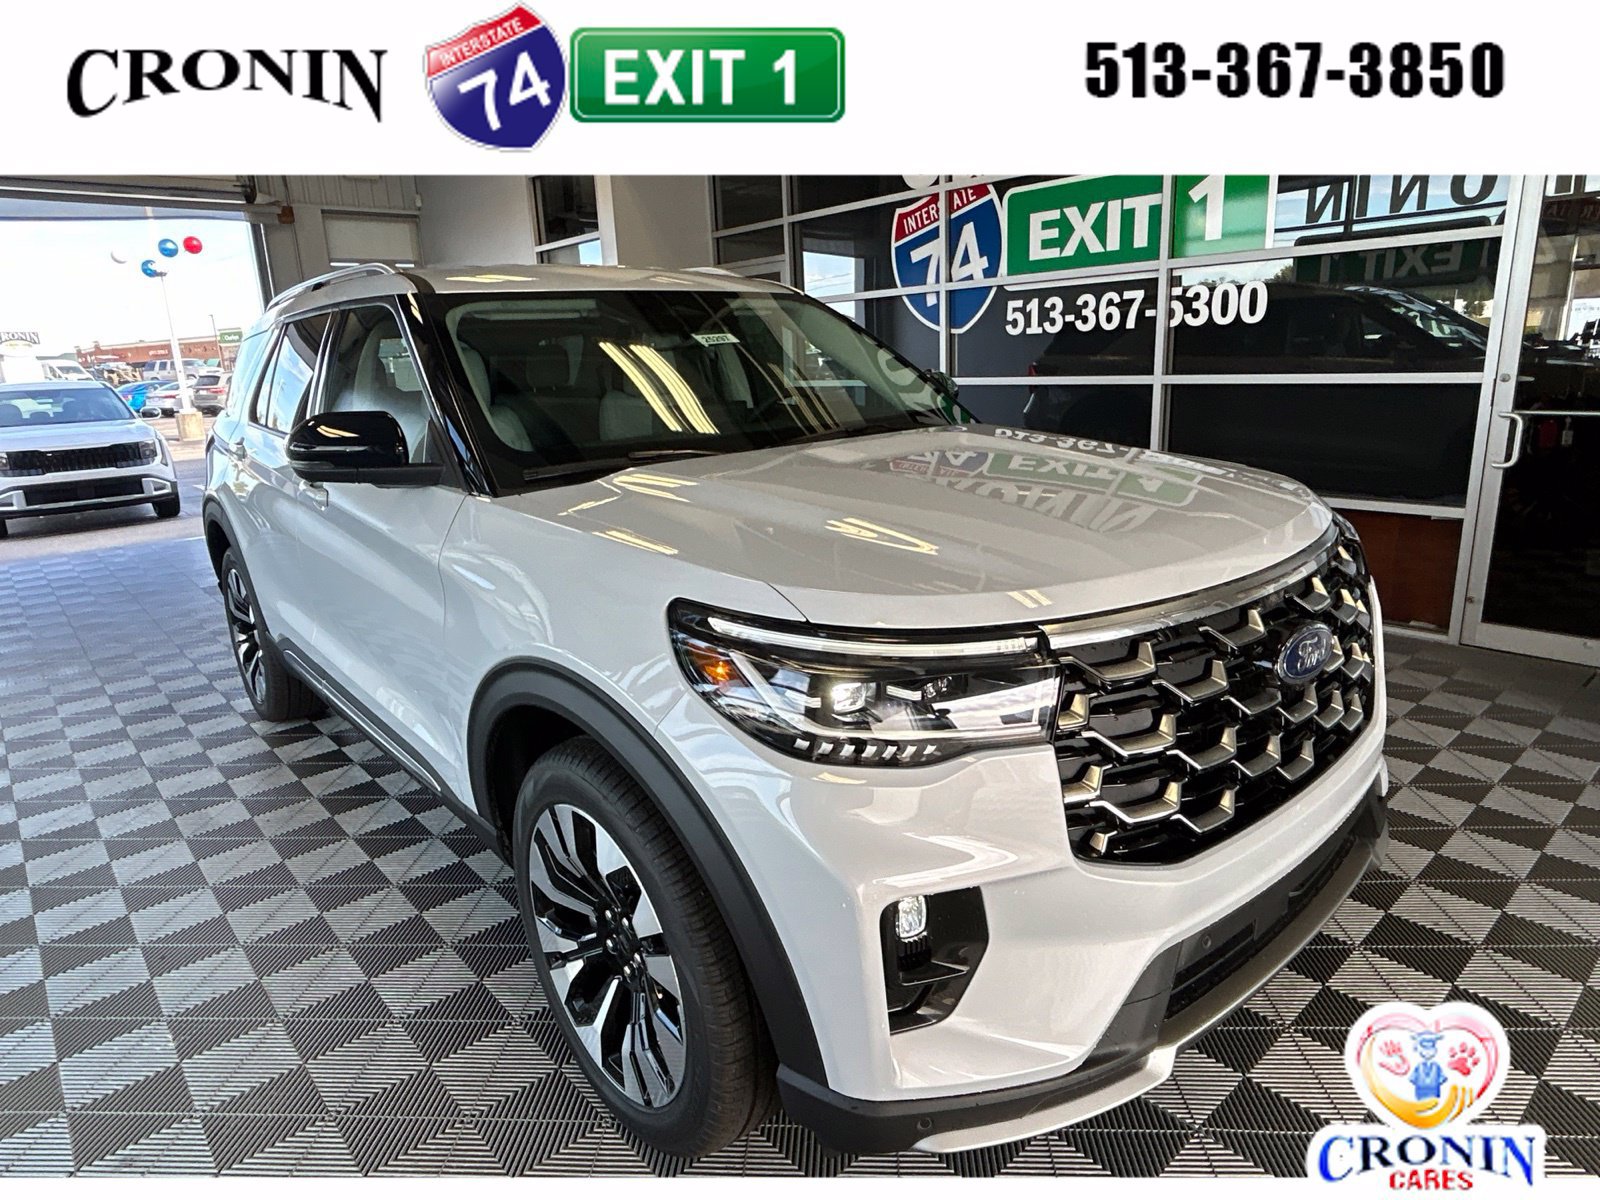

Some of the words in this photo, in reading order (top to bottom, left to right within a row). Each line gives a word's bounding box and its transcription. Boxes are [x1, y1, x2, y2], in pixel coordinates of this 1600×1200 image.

[903, 188, 976, 234] INTERATE
[1029, 193, 1162, 261] EXIT
[1188, 175, 1225, 241] 1
[910, 221, 989, 307] 74
[1005, 281, 1268, 335] 513-367-5300
[0, 331, 40, 344] RONIN
[1297, 636, 1327, 672] Ford
